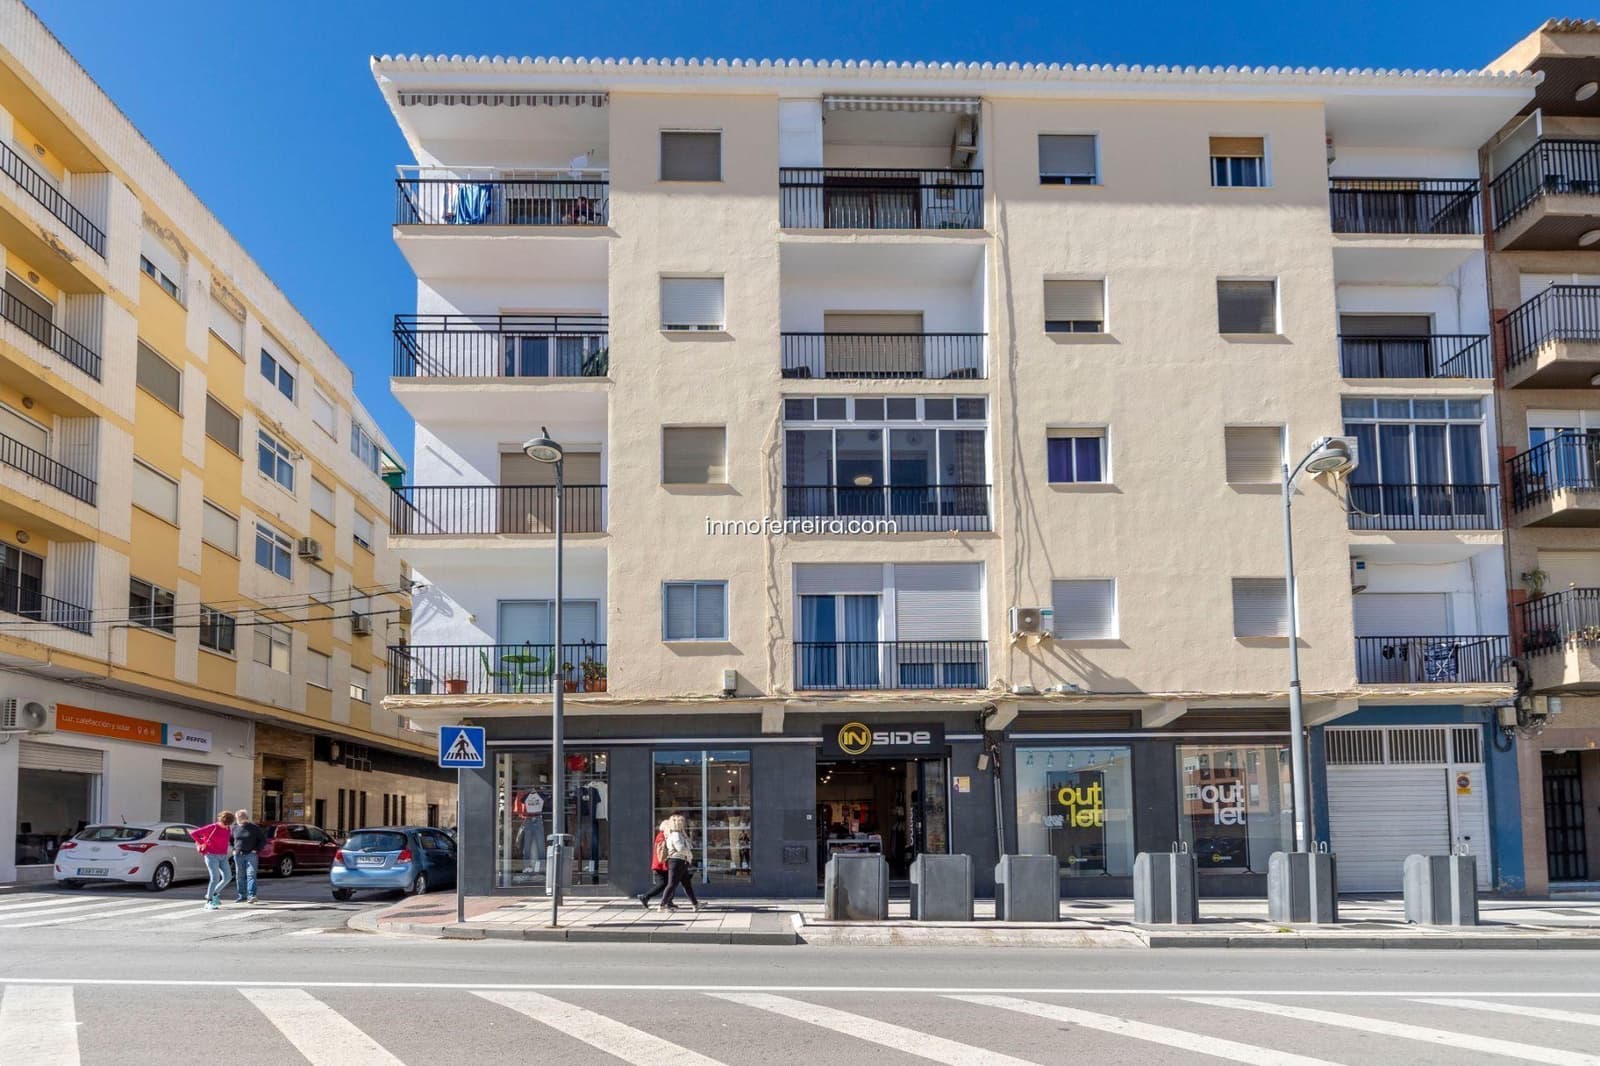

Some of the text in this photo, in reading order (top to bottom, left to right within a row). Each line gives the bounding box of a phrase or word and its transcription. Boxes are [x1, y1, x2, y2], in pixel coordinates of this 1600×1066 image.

[1058, 782, 1103, 806] out
[1201, 780, 1245, 804] out
[1071, 801, 1104, 828] let
[1214, 801, 1246, 825] let
